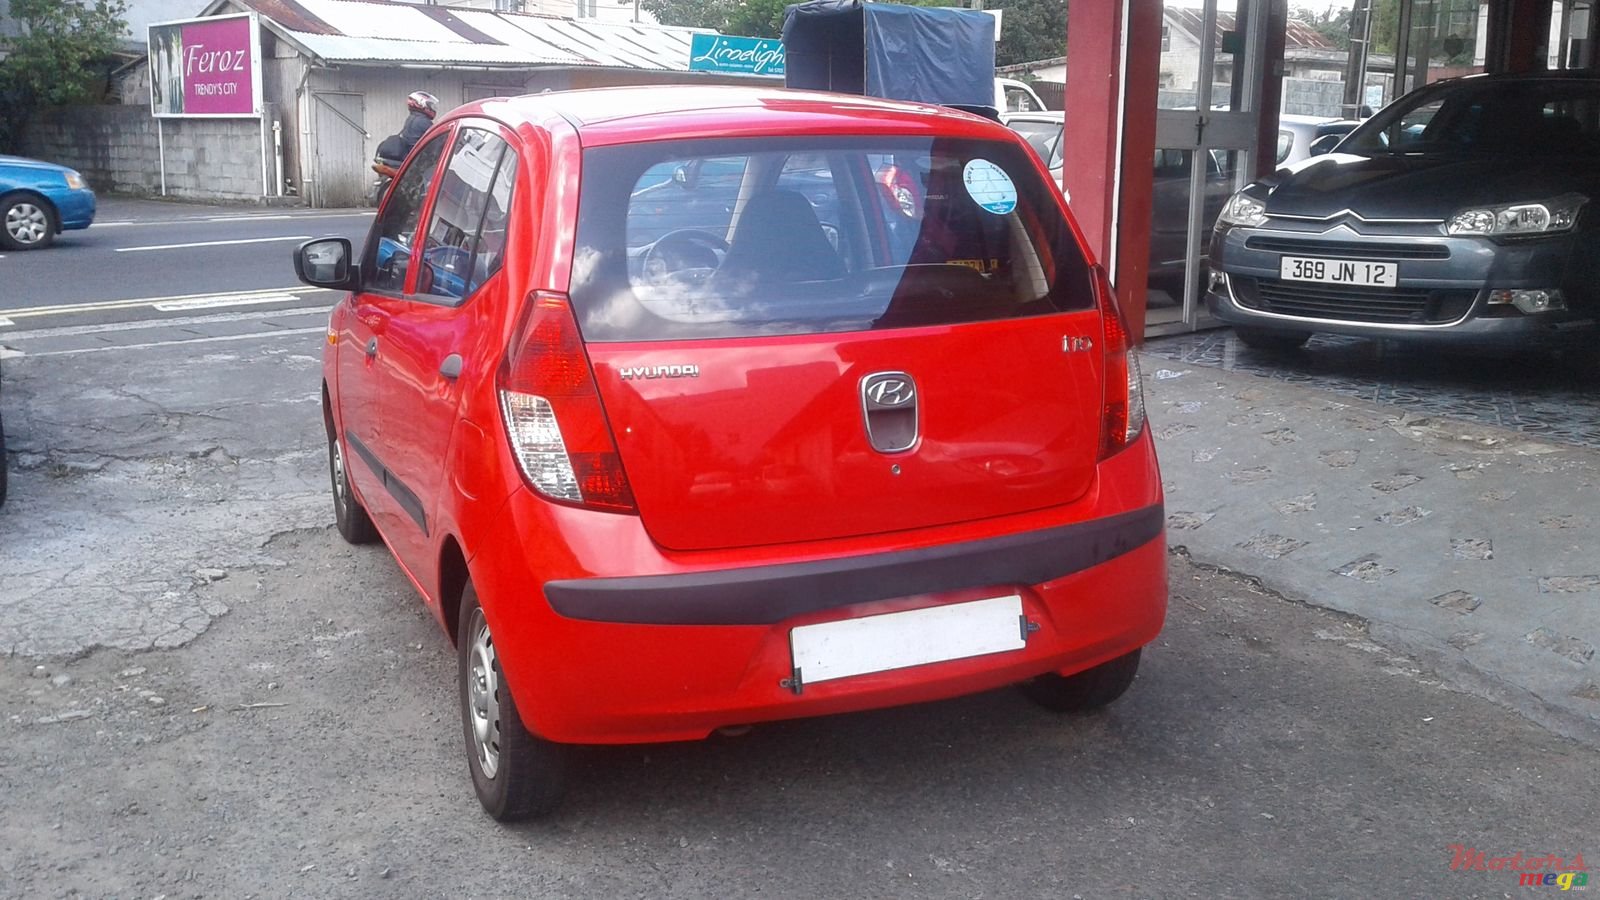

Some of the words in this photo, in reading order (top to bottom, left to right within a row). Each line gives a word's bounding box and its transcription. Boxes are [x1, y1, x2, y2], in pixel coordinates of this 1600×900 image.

[183, 44, 245, 77] Feroz
[194, 82, 223, 96] TRENDY'S
[223, 82, 238, 95] CITY
[1292, 260, 1326, 280] 369
[1331, 262, 1355, 282] JN
[1364, 264, 1386, 284] 12
[620, 364, 699, 380] HYUNDAI
